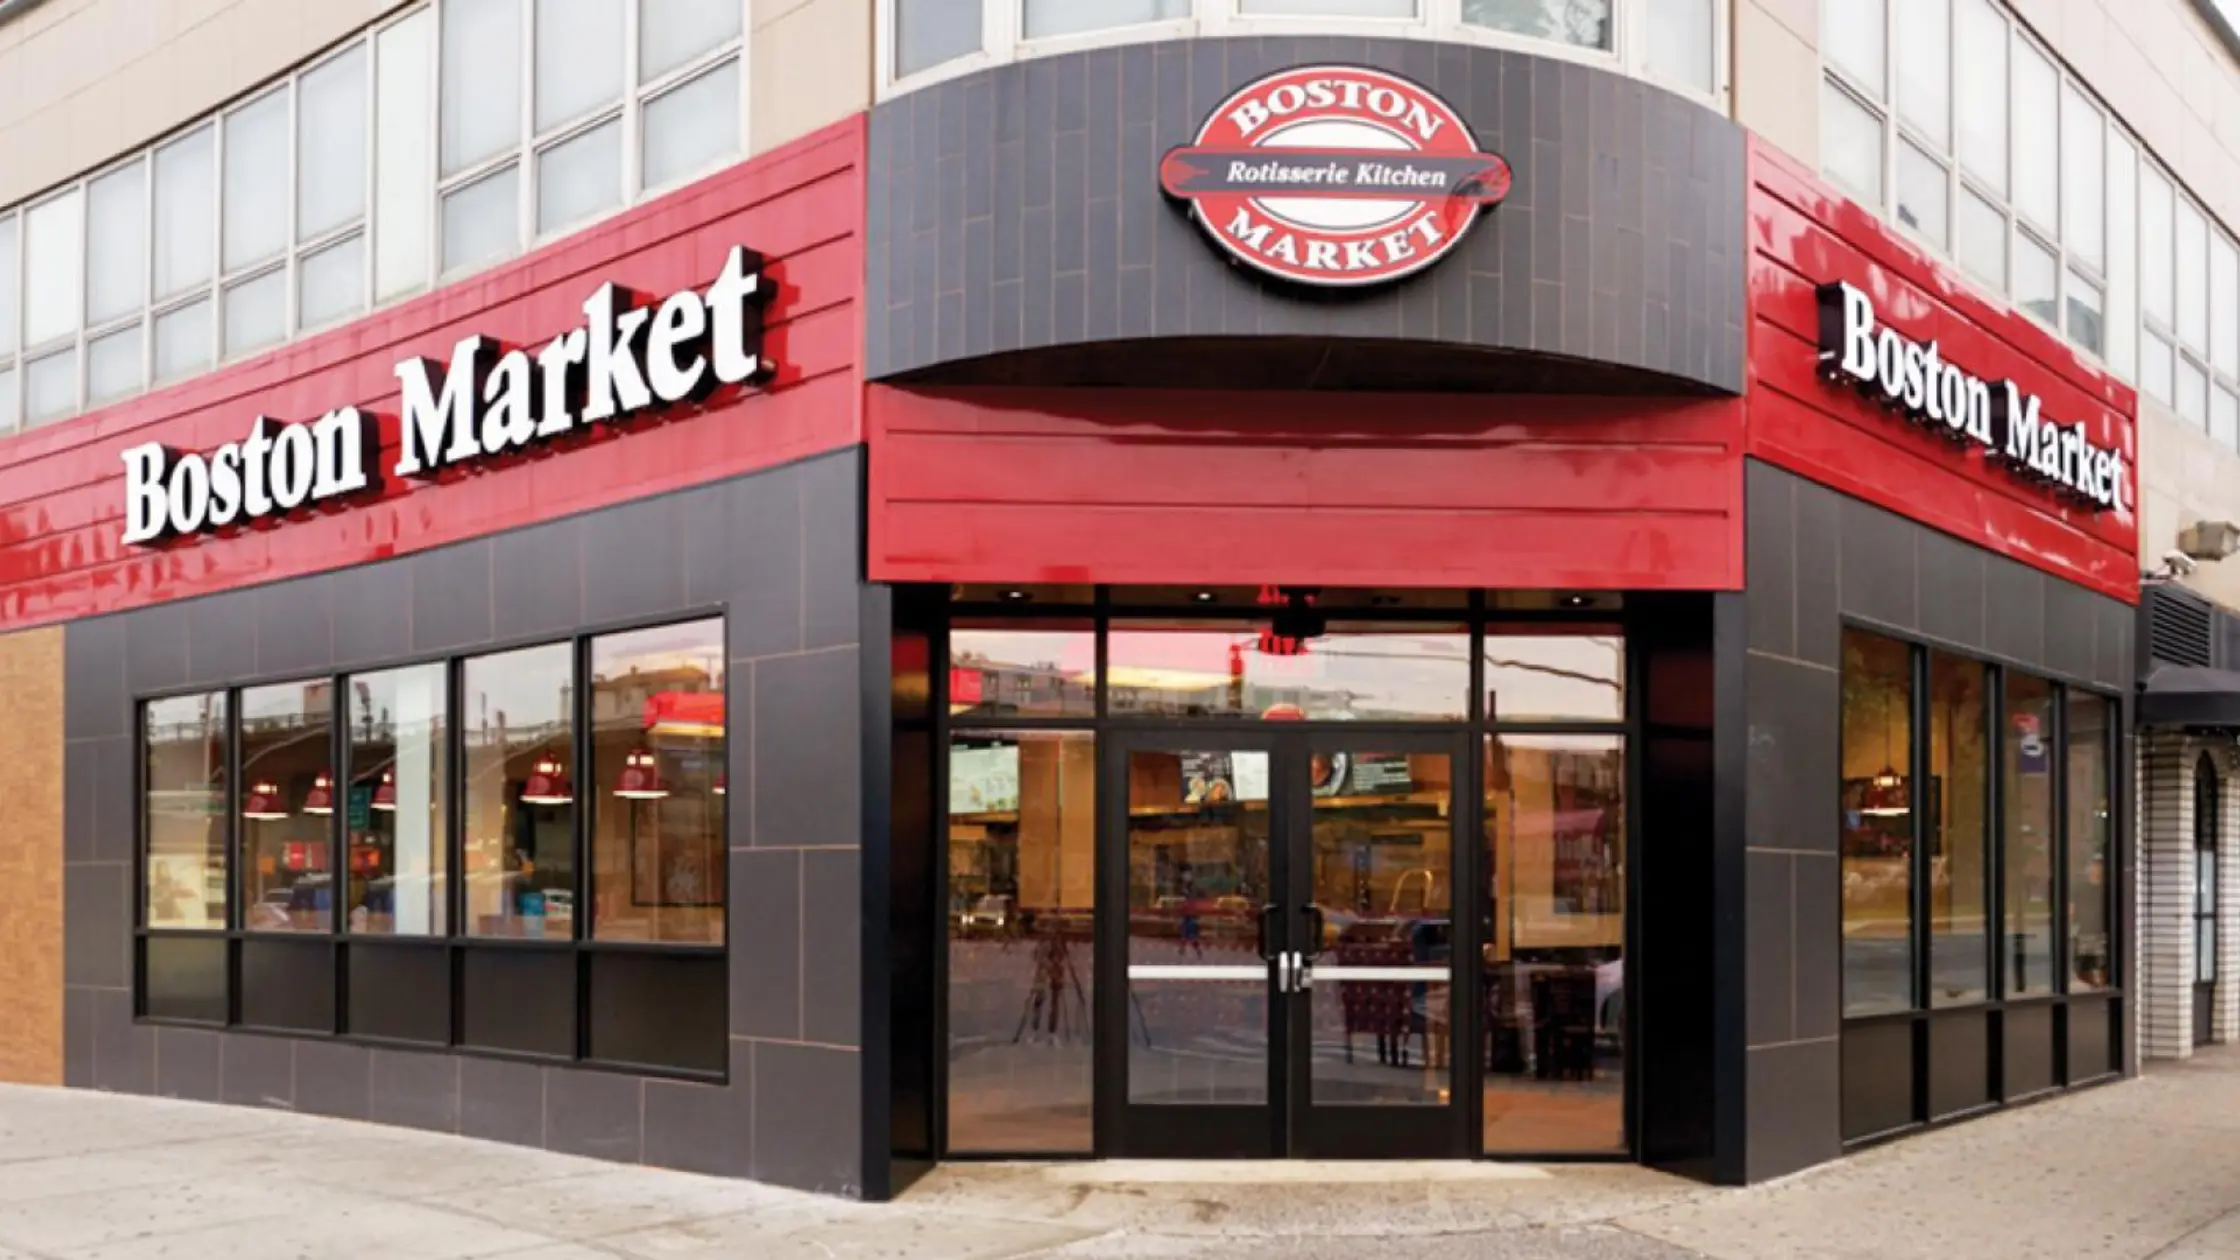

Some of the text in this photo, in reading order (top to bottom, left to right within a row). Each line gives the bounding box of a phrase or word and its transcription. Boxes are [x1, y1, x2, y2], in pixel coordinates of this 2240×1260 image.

[1230, 79, 1444, 140] BOSTON
[1226, 161, 1447, 187] Rotisserie Kitchen
[1226, 207, 1444, 270] MARKET
[121, 244, 758, 545] Boston Market
[1840, 280, 2125, 513] Boston Market
